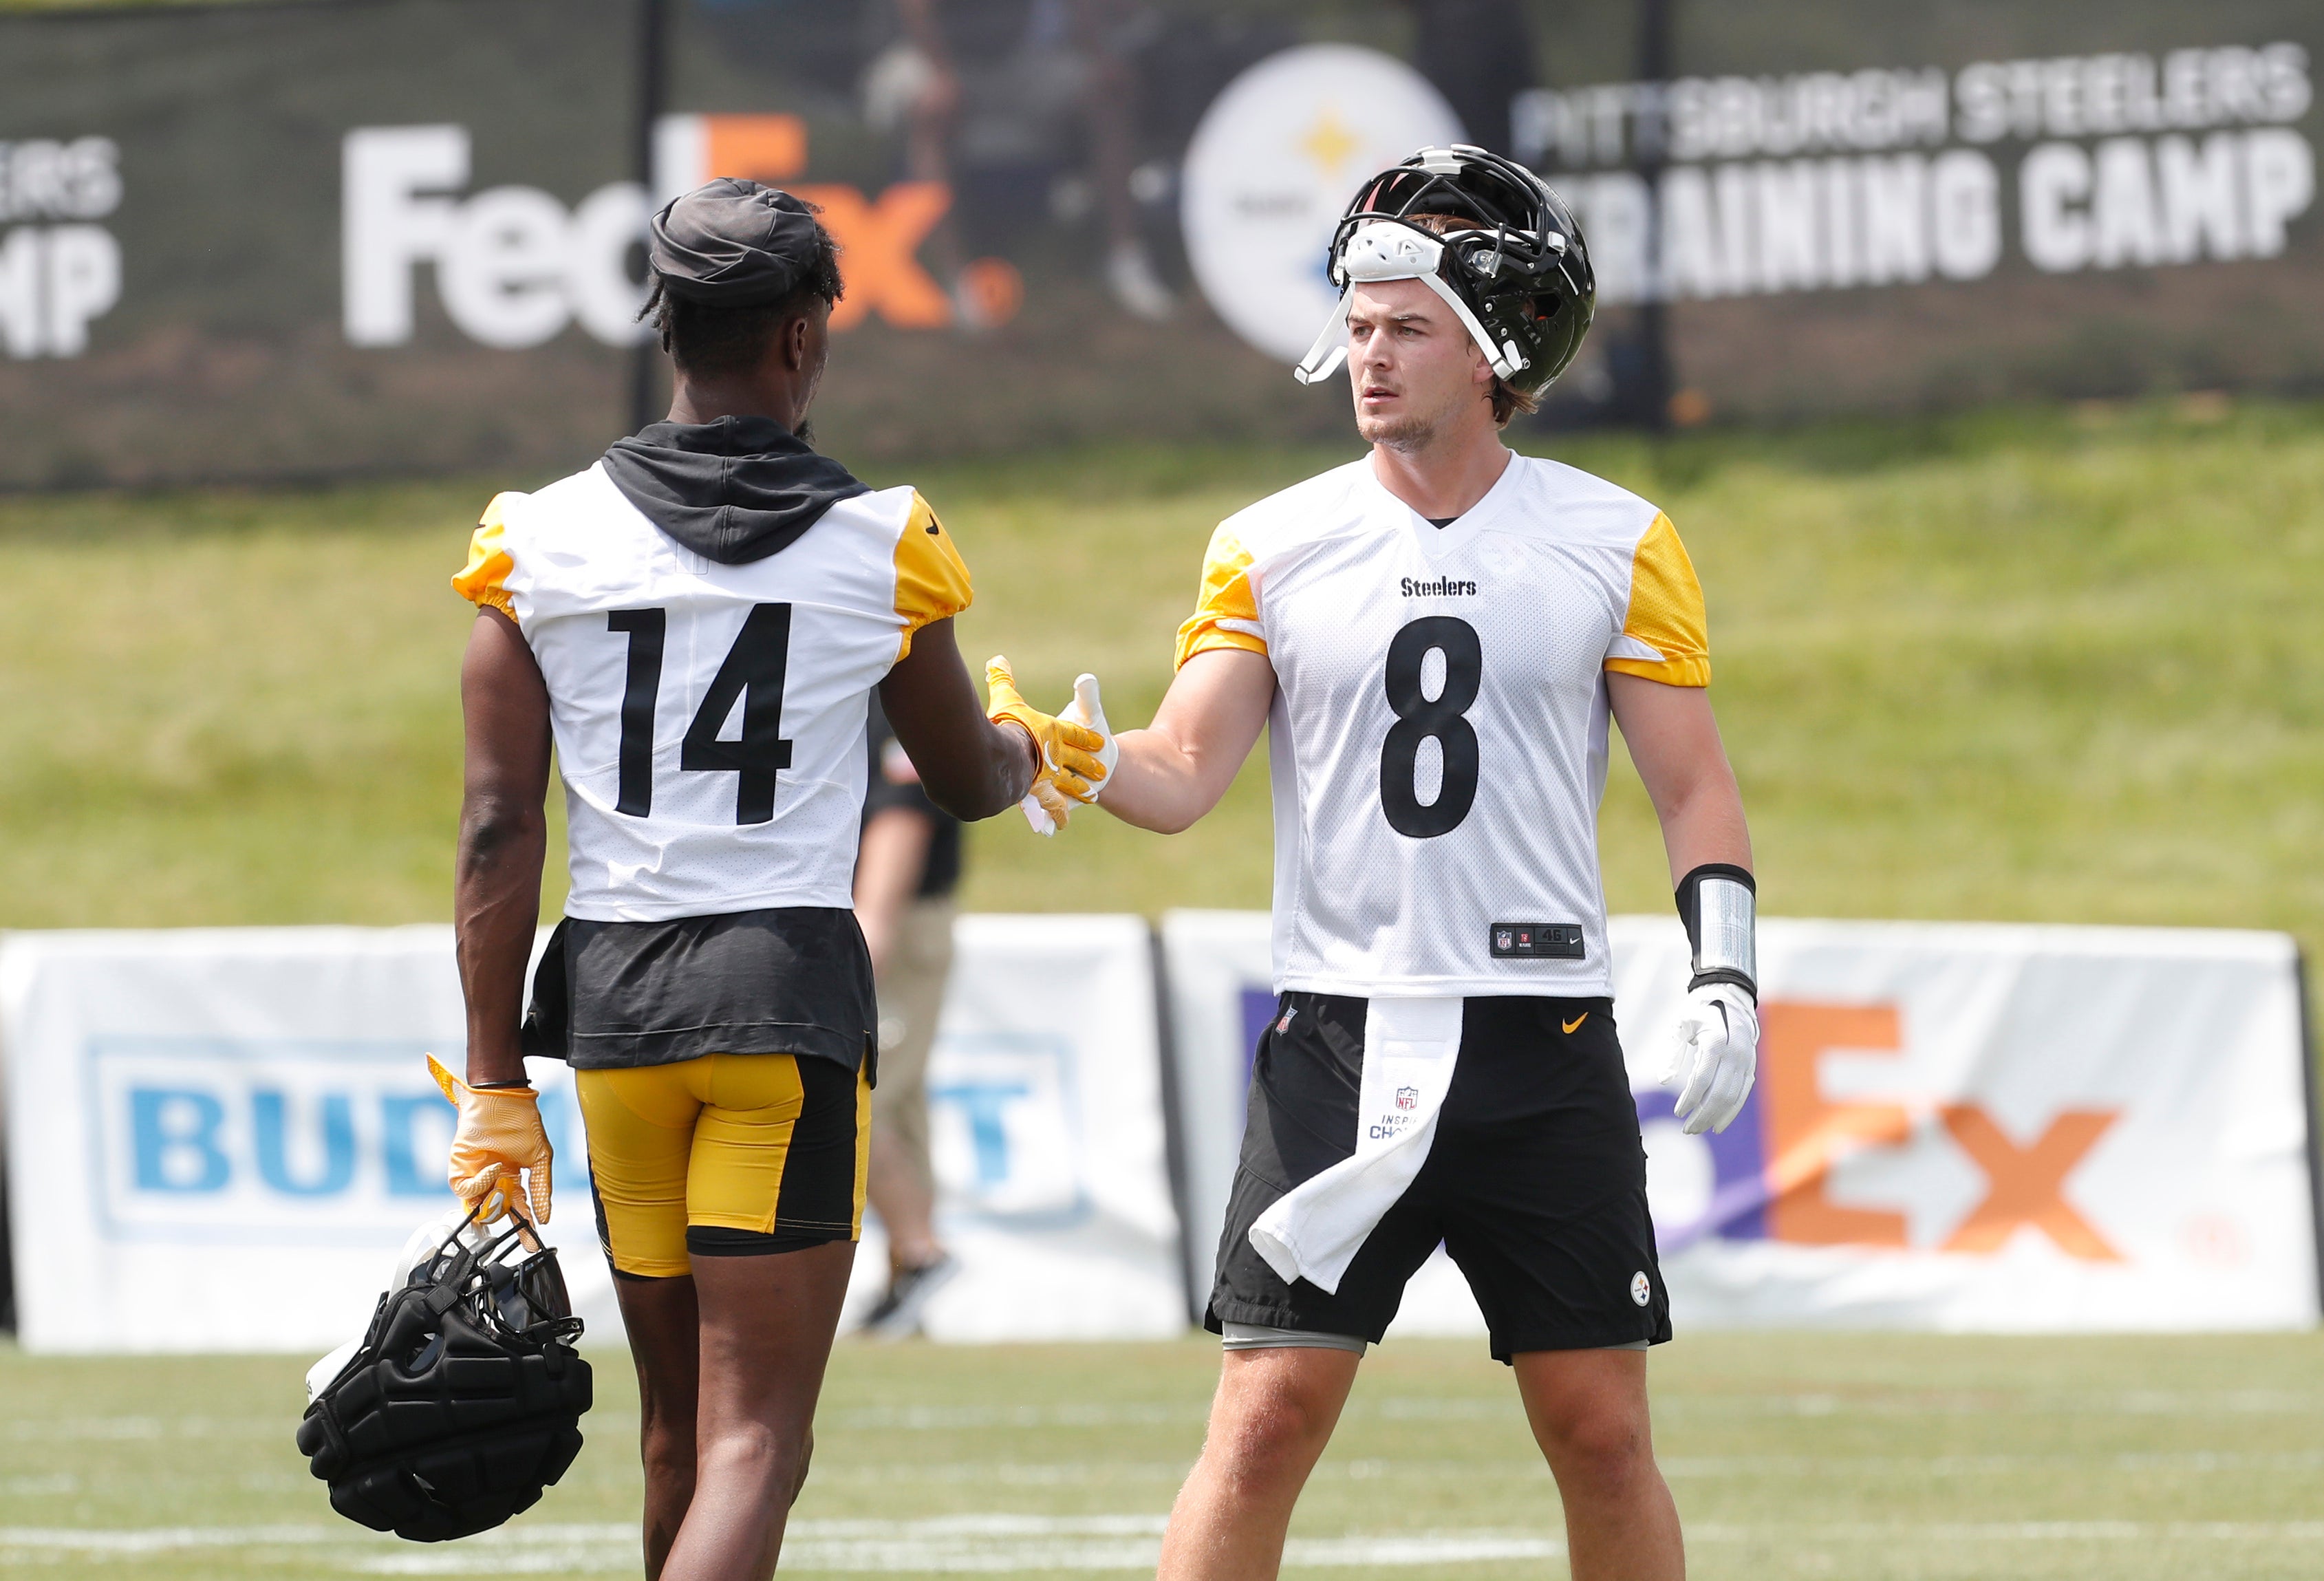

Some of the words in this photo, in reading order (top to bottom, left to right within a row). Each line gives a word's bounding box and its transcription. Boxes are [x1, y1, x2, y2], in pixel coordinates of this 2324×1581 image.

[1511, 67, 1948, 166] PITTSBURGH
[1954, 41, 2314, 143] STEELERS
[2019, 126, 2316, 273] CAMP
[1401, 575, 1477, 598] Steelers
[608, 602, 793, 826] 14
[1380, 616, 1483, 839] 8
[1542, 929, 1562, 942] 46
[1397, 1097, 1416, 1110] NFL
